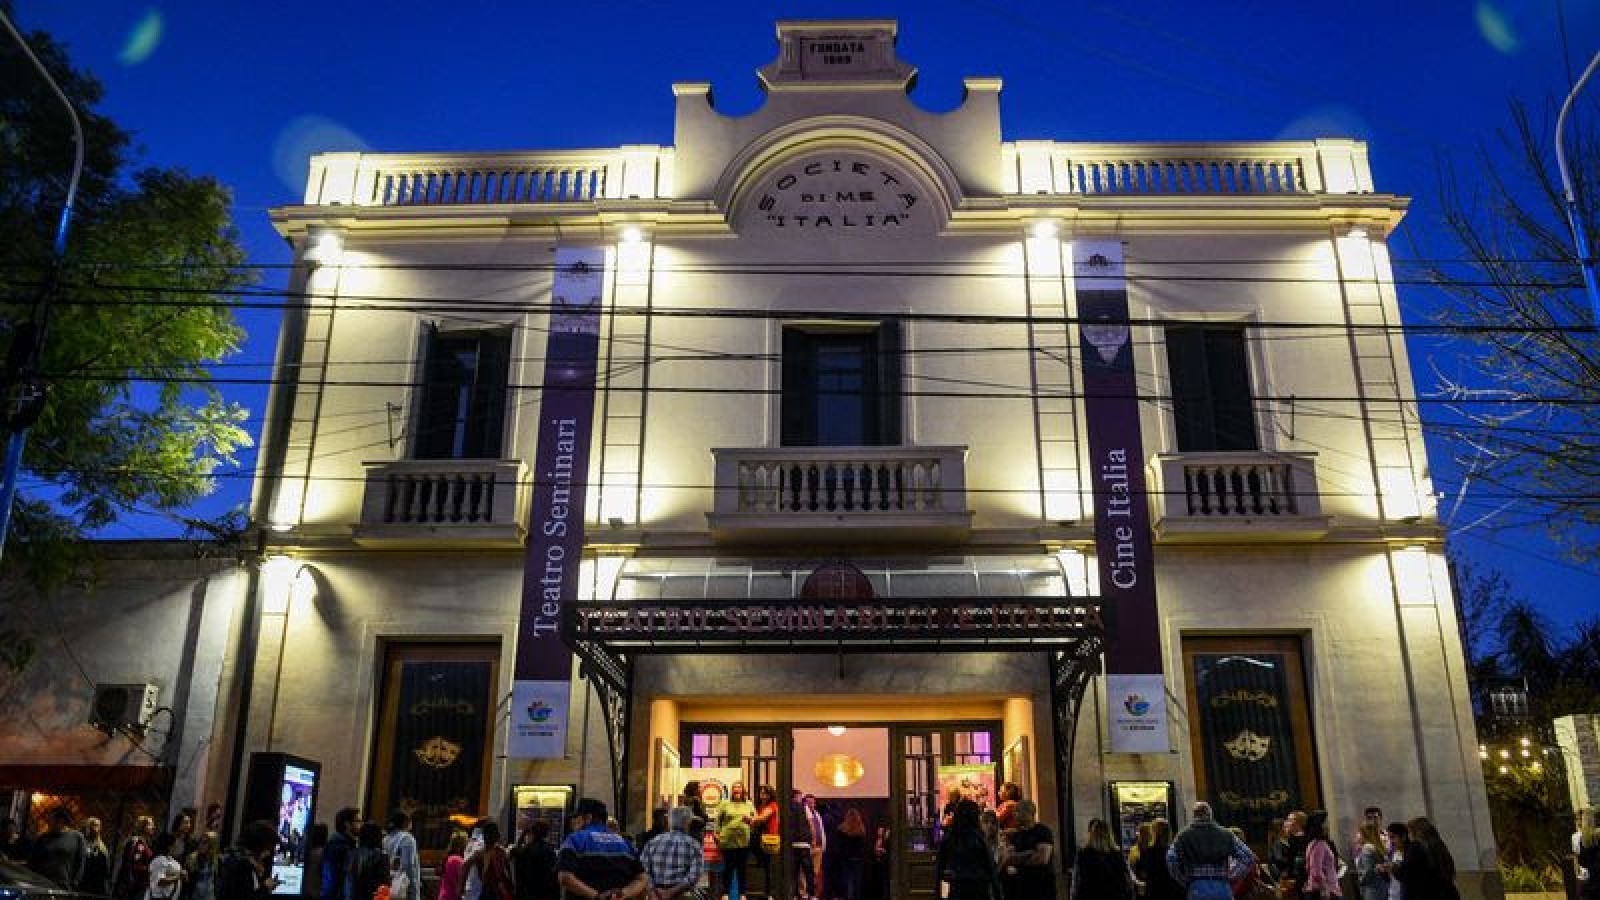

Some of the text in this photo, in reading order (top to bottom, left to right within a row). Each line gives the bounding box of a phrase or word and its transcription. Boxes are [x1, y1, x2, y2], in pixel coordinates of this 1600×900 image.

[758, 160, 917, 211] SOCIETA
[533, 417, 577, 638] Teatro Seminari
[1102, 448, 1137, 589] Cine Italia
[577, 607, 707, 632] TEATRO
